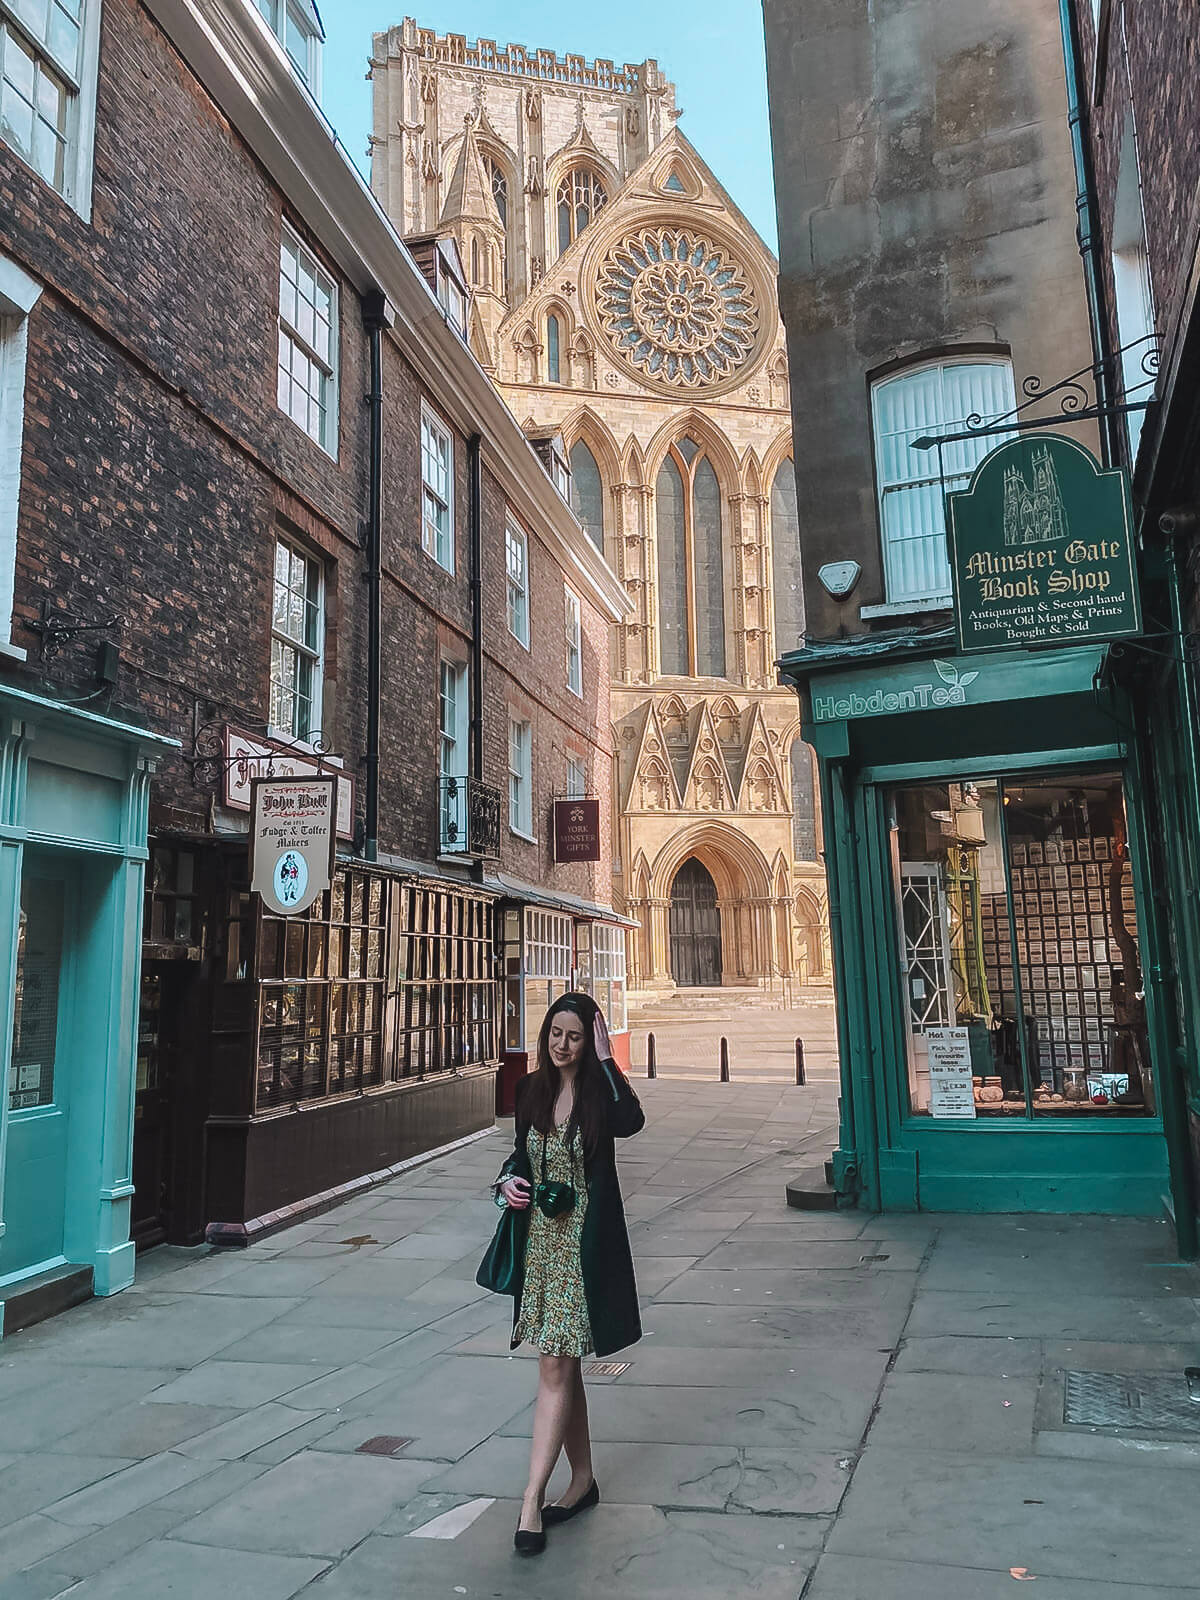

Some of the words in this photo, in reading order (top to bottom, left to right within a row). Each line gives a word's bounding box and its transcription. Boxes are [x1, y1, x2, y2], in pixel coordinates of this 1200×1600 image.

[965, 549, 1057, 580] Minster
[1064, 538, 1121, 565] Gate
[979, 574, 1041, 605] Book
[1047, 569, 1111, 595] Shop
[968, 605, 1035, 620] Antiquarian
[1037, 601, 1051, 612] &
[1052, 595, 1094, 610] Second
[1096, 592, 1126, 604] hand
[973, 620, 1012, 632] Books,
[1014, 615, 1035, 626] Old
[1037, 612, 1069, 624] Maps
[1071, 609, 1084, 620] &
[1088, 606, 1123, 618] Prints
[1006, 627, 1046, 639] Bought
[1049, 624, 1063, 634] &
[1065, 620, 1089, 633] Sold
[262, 795, 295, 812] John
[297, 793, 328, 810] Bull
[260, 826, 288, 838] Fudge
[290, 826, 298, 836] &
[300, 825, 327, 836] Toffee
[567, 825, 589, 833] YORK
[276, 838, 309, 849] Makers
[560, 834, 595, 842] MINSTER
[566, 844, 590, 852] GIFTS
[928, 1031, 944, 1039] Hot
